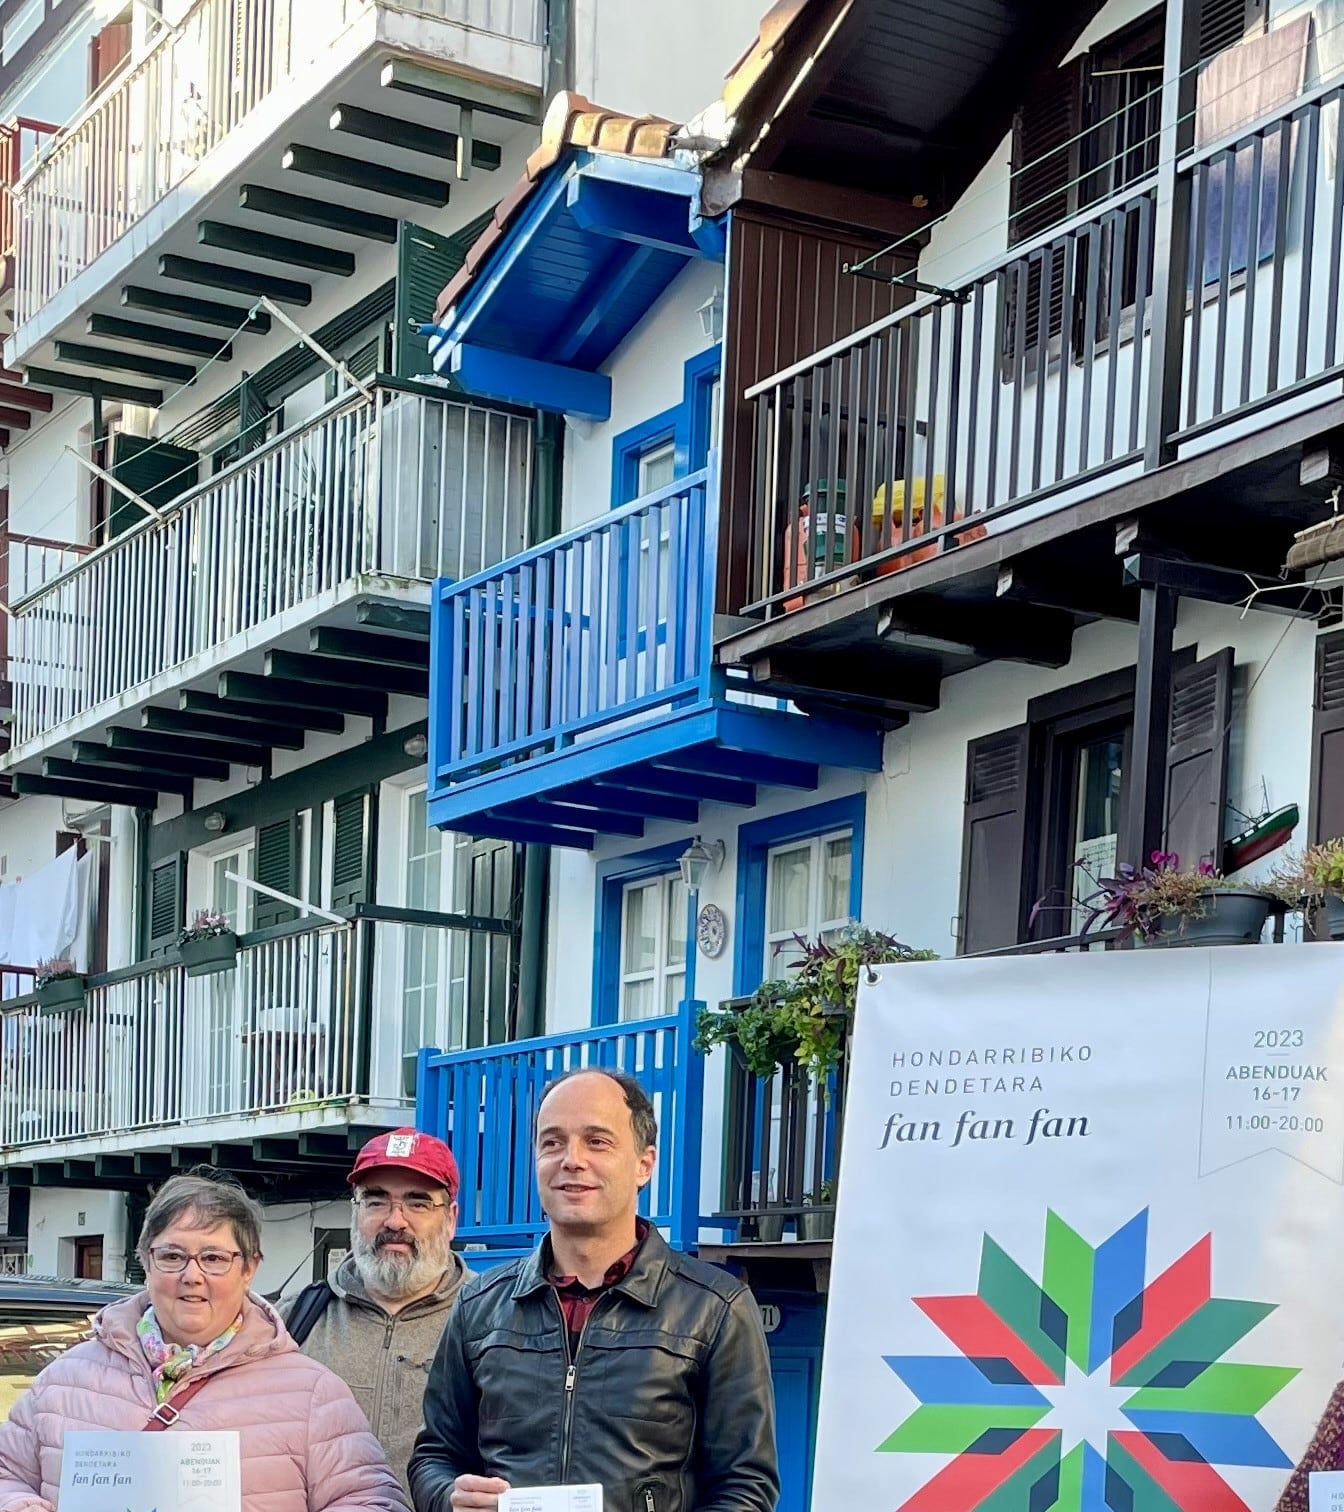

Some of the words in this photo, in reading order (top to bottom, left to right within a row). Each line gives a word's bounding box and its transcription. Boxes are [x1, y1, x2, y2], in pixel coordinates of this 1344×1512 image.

[1253, 1029, 1304, 1048] 2023
[892, 1045, 1092, 1068] HONDARRIBIKO
[1225, 1064, 1329, 1081] ABENDUAK
[889, 1076, 1044, 1097] DENDETARA
[1252, 1086, 1301, 1101] 16-17
[877, 1112, 943, 1151] fan
[949, 1110, 1017, 1148] fan
[1023, 1108, 1093, 1146] fan
[1226, 1115, 1324, 1133] 11:00-20:00
[71, 1472, 89, 1487] fan
[91, 1472, 110, 1487] fan
[113, 1472, 132, 1487] fan
